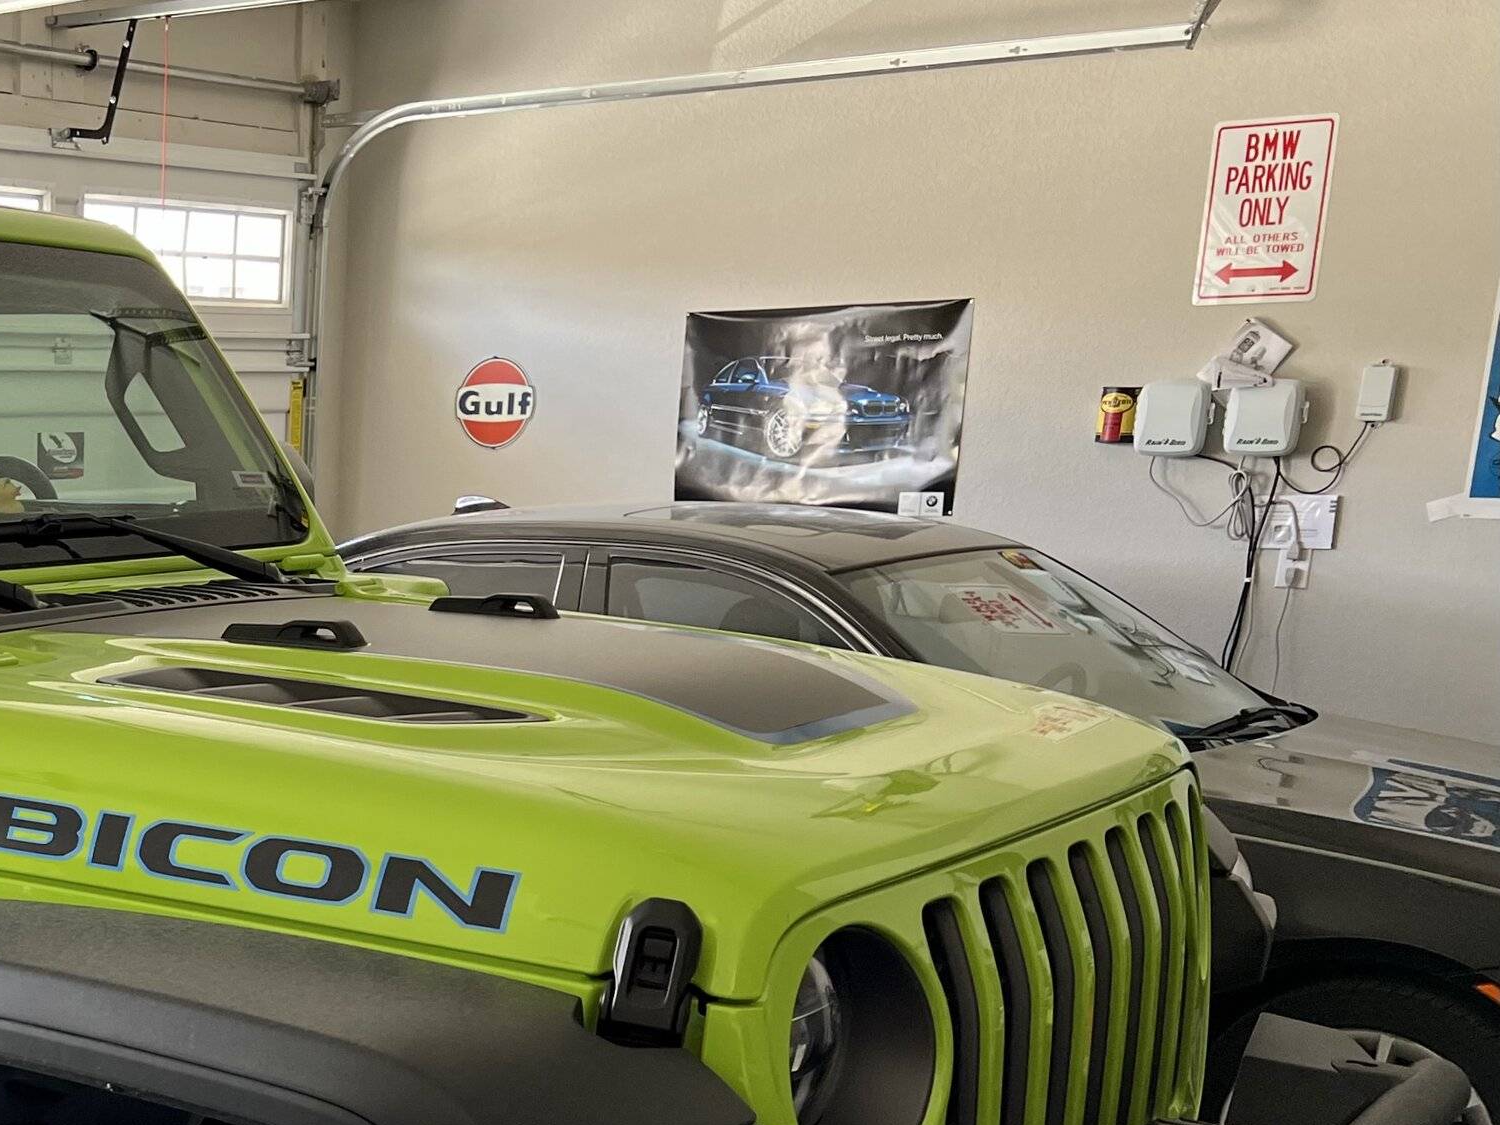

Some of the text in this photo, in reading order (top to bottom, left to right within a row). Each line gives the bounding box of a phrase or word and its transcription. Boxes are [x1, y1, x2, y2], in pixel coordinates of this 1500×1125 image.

[1245, 130, 1301, 162] BMW
[1225, 160, 1313, 195] PARKING
[1238, 196, 1290, 227] ONLY
[1216, 243, 1305, 256] WILL BE TOWED
[1224, 232, 1299, 244] ALL OTHERS
[903, 333, 922, 342] Pretty
[458, 390, 532, 416] Gulf
